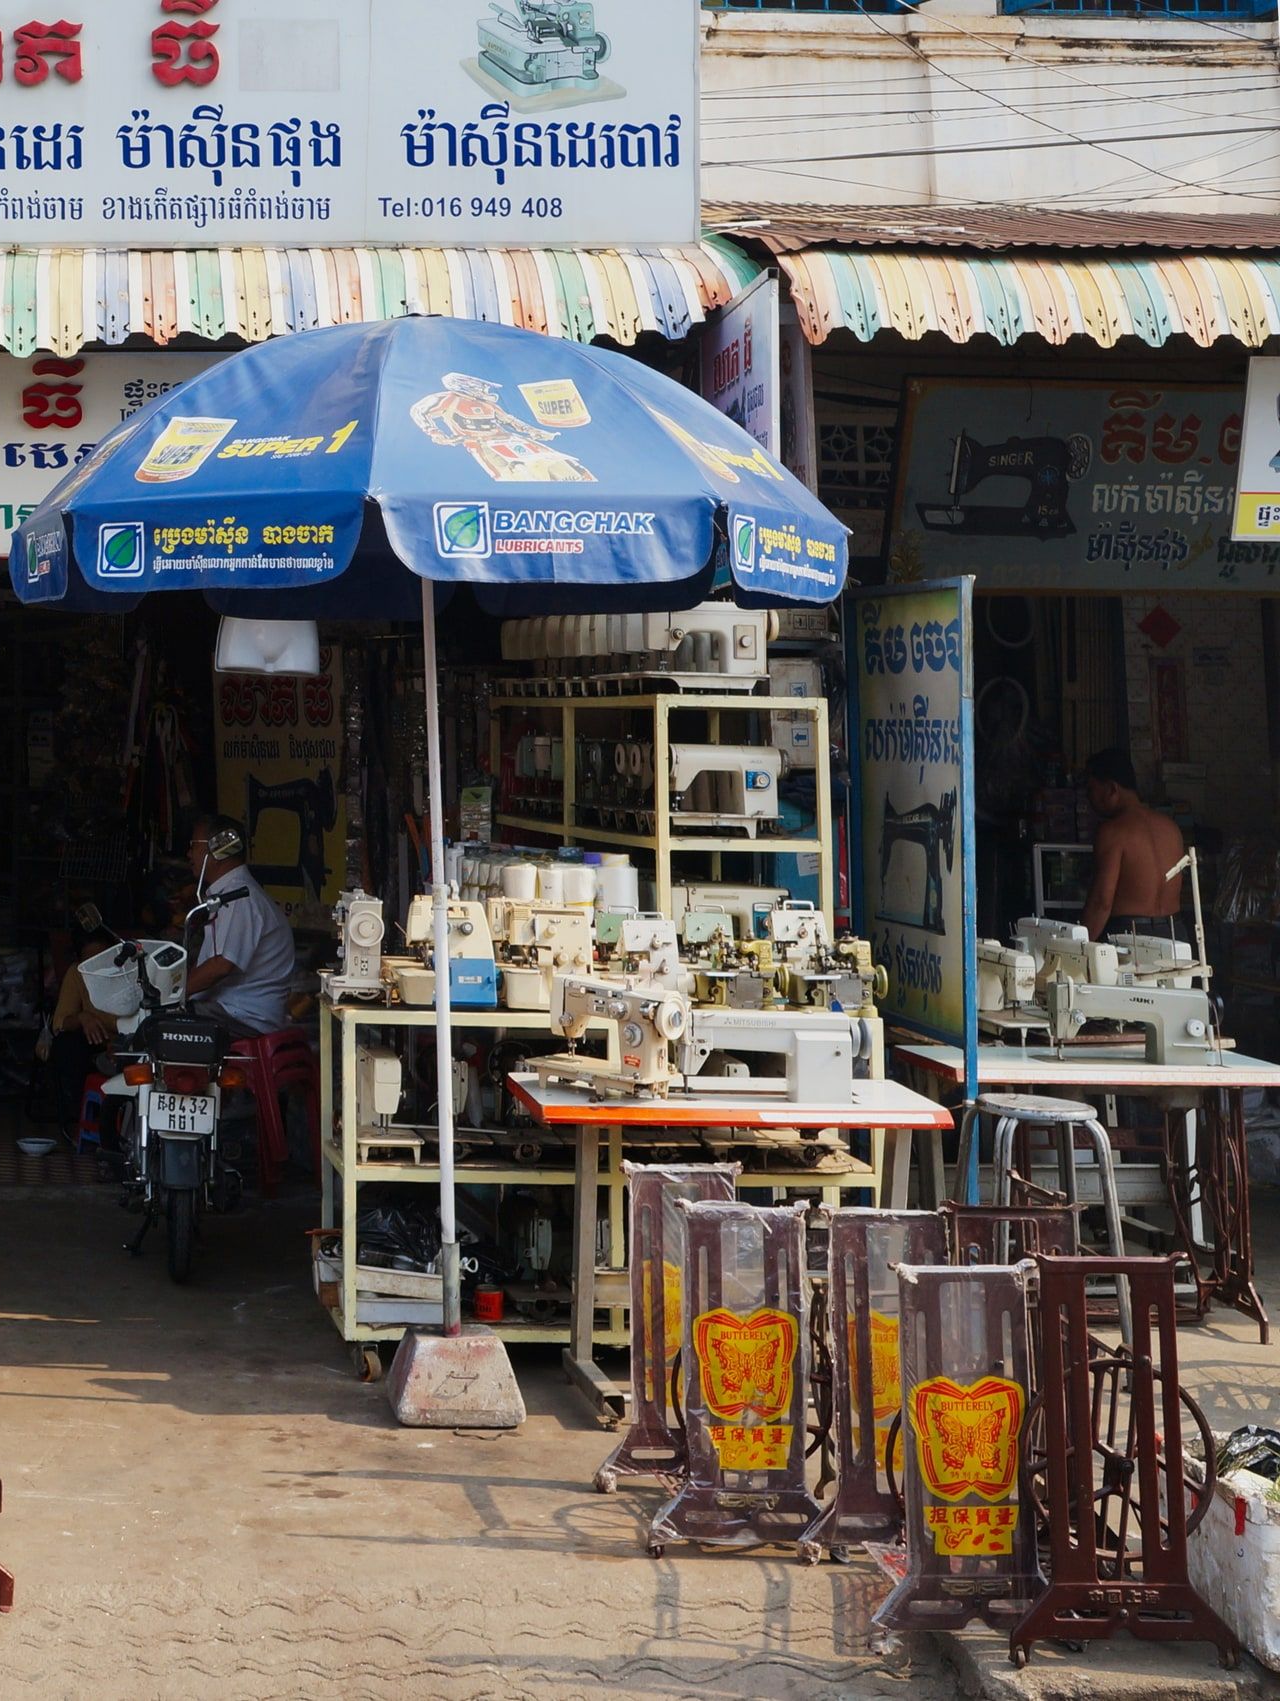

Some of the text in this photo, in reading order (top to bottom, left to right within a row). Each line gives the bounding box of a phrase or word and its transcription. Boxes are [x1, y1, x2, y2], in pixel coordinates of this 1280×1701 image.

[377, 197, 563, 218] Tel:016 949 408
[216, 420, 359, 459] SUPER 1
[987, 450, 1034, 467] SINGER
[493, 511, 656, 535] BANGCHAK
[496, 539, 584, 554] LUBRICANTS
[1129, 996, 1154, 1005] JUKI
[733, 1018, 777, 1027] MITSUBISHI
[162, 1032, 214, 1043] HONDA
[168, 1096, 208, 1115] 8432
